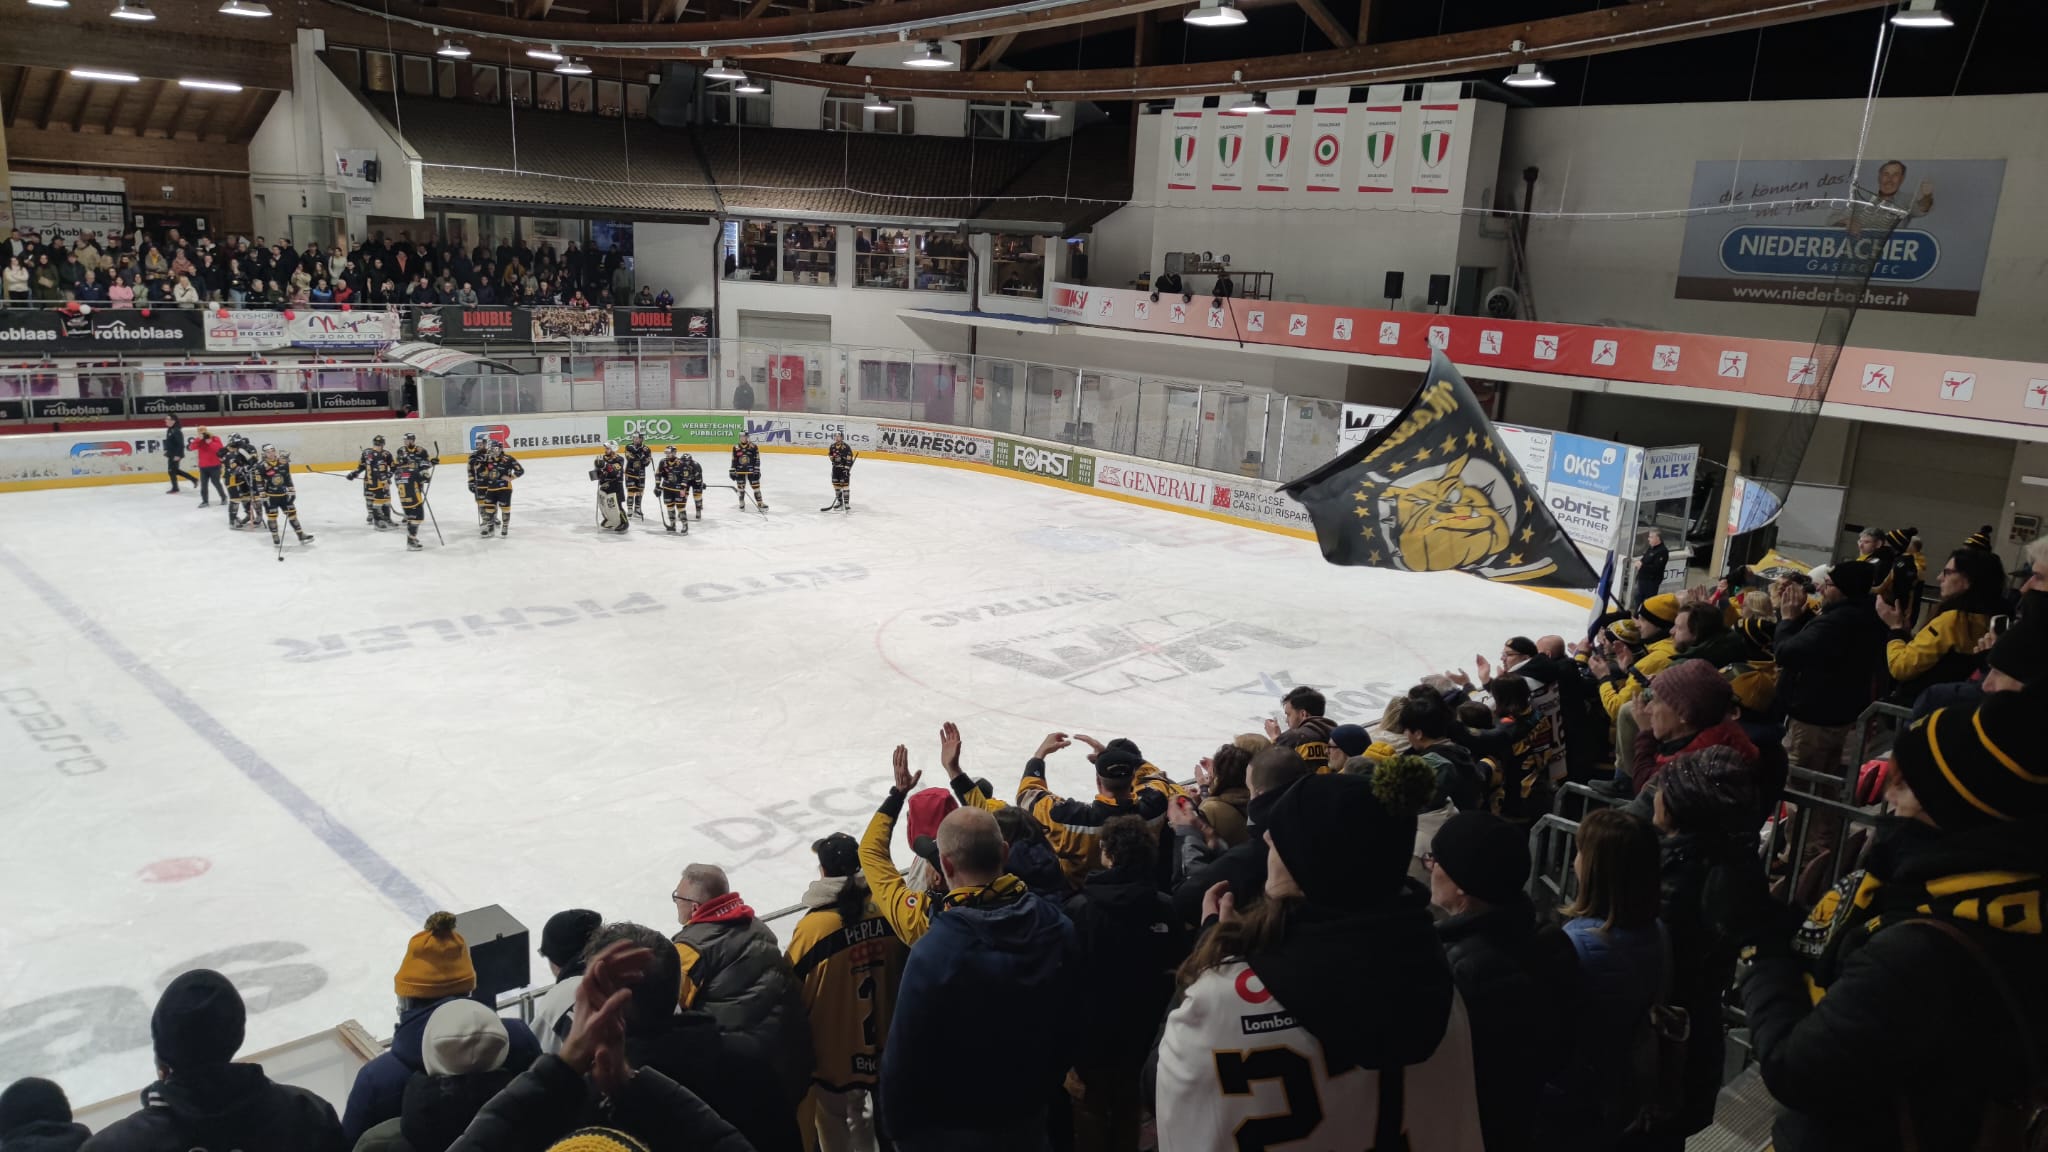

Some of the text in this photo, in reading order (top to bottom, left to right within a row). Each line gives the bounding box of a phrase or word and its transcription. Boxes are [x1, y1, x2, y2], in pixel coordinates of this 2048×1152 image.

[1739, 234, 1919, 262] NIEDERBACHER
[463, 311, 513, 327] DOUBLE
[630, 312, 673, 327] DOUBLE
[94, 326, 184, 340] rothoblaas
[43, 403, 110, 416] rothoblaas
[143, 401, 206, 414] rothoblaas
[237, 399, 296, 410] rothoblaas
[323, 397, 377, 406] rothoblaas
[623, 419, 673, 436] DECO
[821, 423, 846, 432] ICE
[513, 436, 539, 448] FREI
[541, 435, 550, 446] &
[551, 433, 602, 446] RIEGLER
[1014, 445, 1073, 478] FORST
[1652, 463, 1691, 480] ALEX
[1122, 470, 1207, 504] GENERALI
[1551, 495, 1611, 522] obrist
[1557, 512, 1609, 532] PARTNER
[844, 918, 886, 946] PERLA
[1244, 1013, 1297, 1032] Lomba
